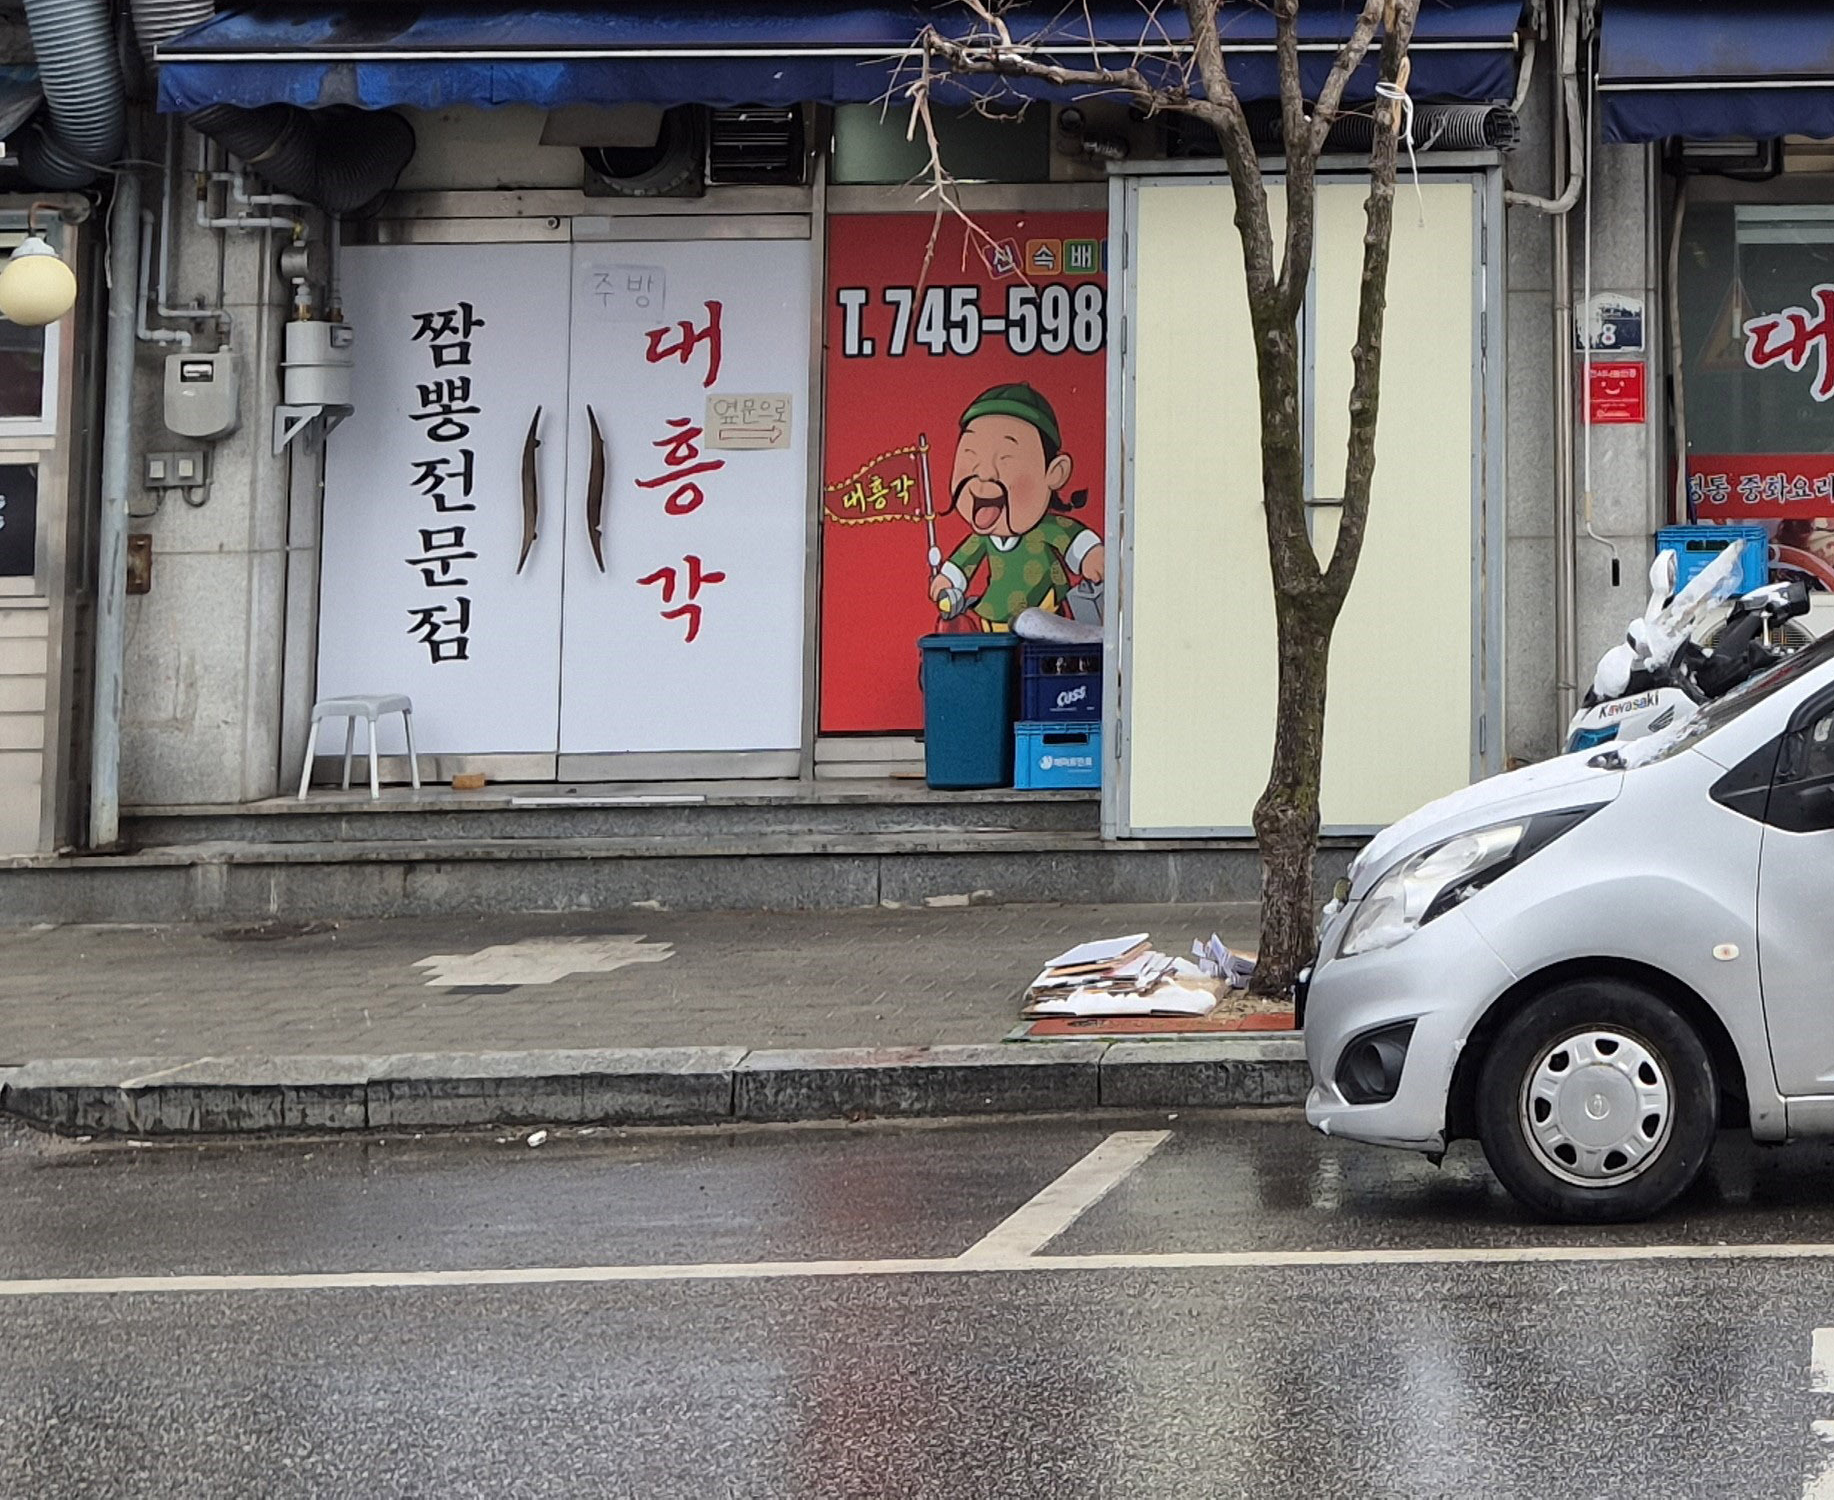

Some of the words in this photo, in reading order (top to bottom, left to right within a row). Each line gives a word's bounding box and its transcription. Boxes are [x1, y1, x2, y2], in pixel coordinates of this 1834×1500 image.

[993, 244, 1100, 273] 신속배
[594, 273, 654, 308] 주방
[837, 283, 1108, 358] T.745-598
[405, 301, 485, 664] 짬뽕전문점
[634, 299, 726, 644] 대흥각
[842, 474, 916, 514] 대흥각
[1599, 690, 1660, 719] Kawasaki
